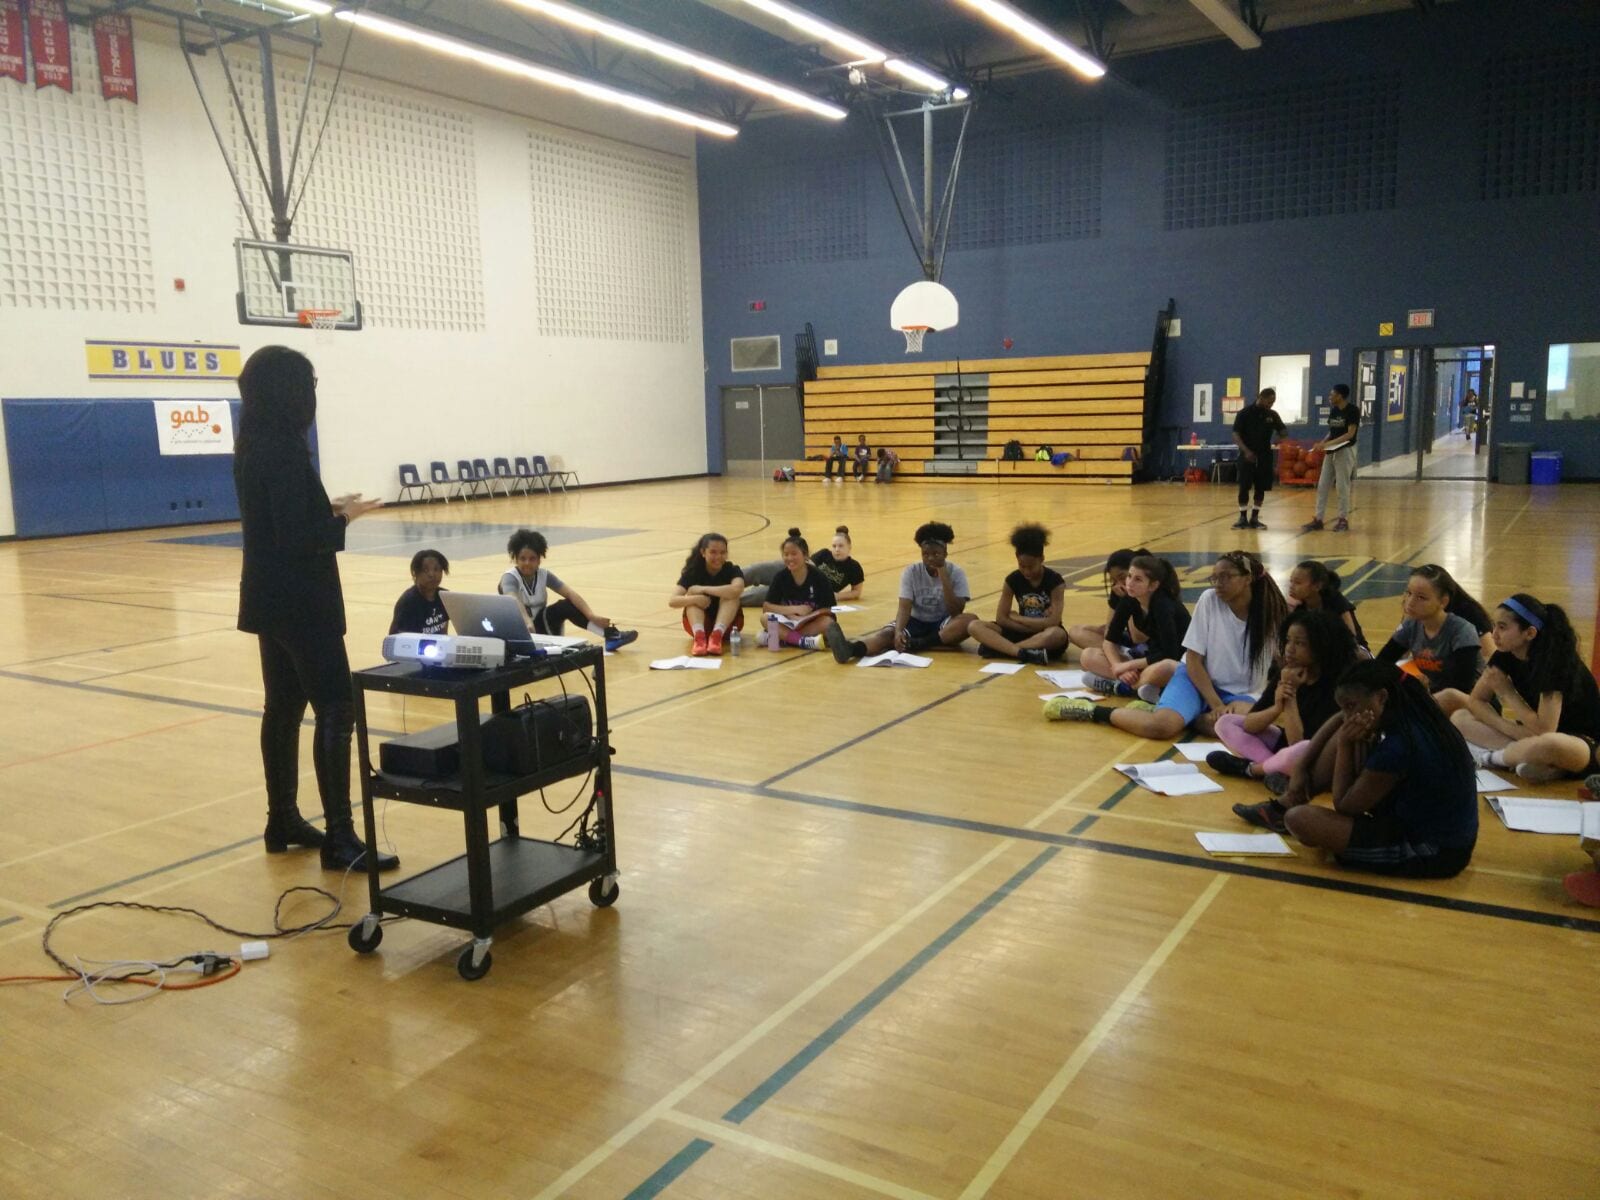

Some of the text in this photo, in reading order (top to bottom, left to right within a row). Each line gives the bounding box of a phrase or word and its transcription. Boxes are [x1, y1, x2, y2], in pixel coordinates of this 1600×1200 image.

[42, 19, 56, 64] RUGBY
[112, 350, 220, 371] BLUES
[170, 405, 210, 429] g.a.b
